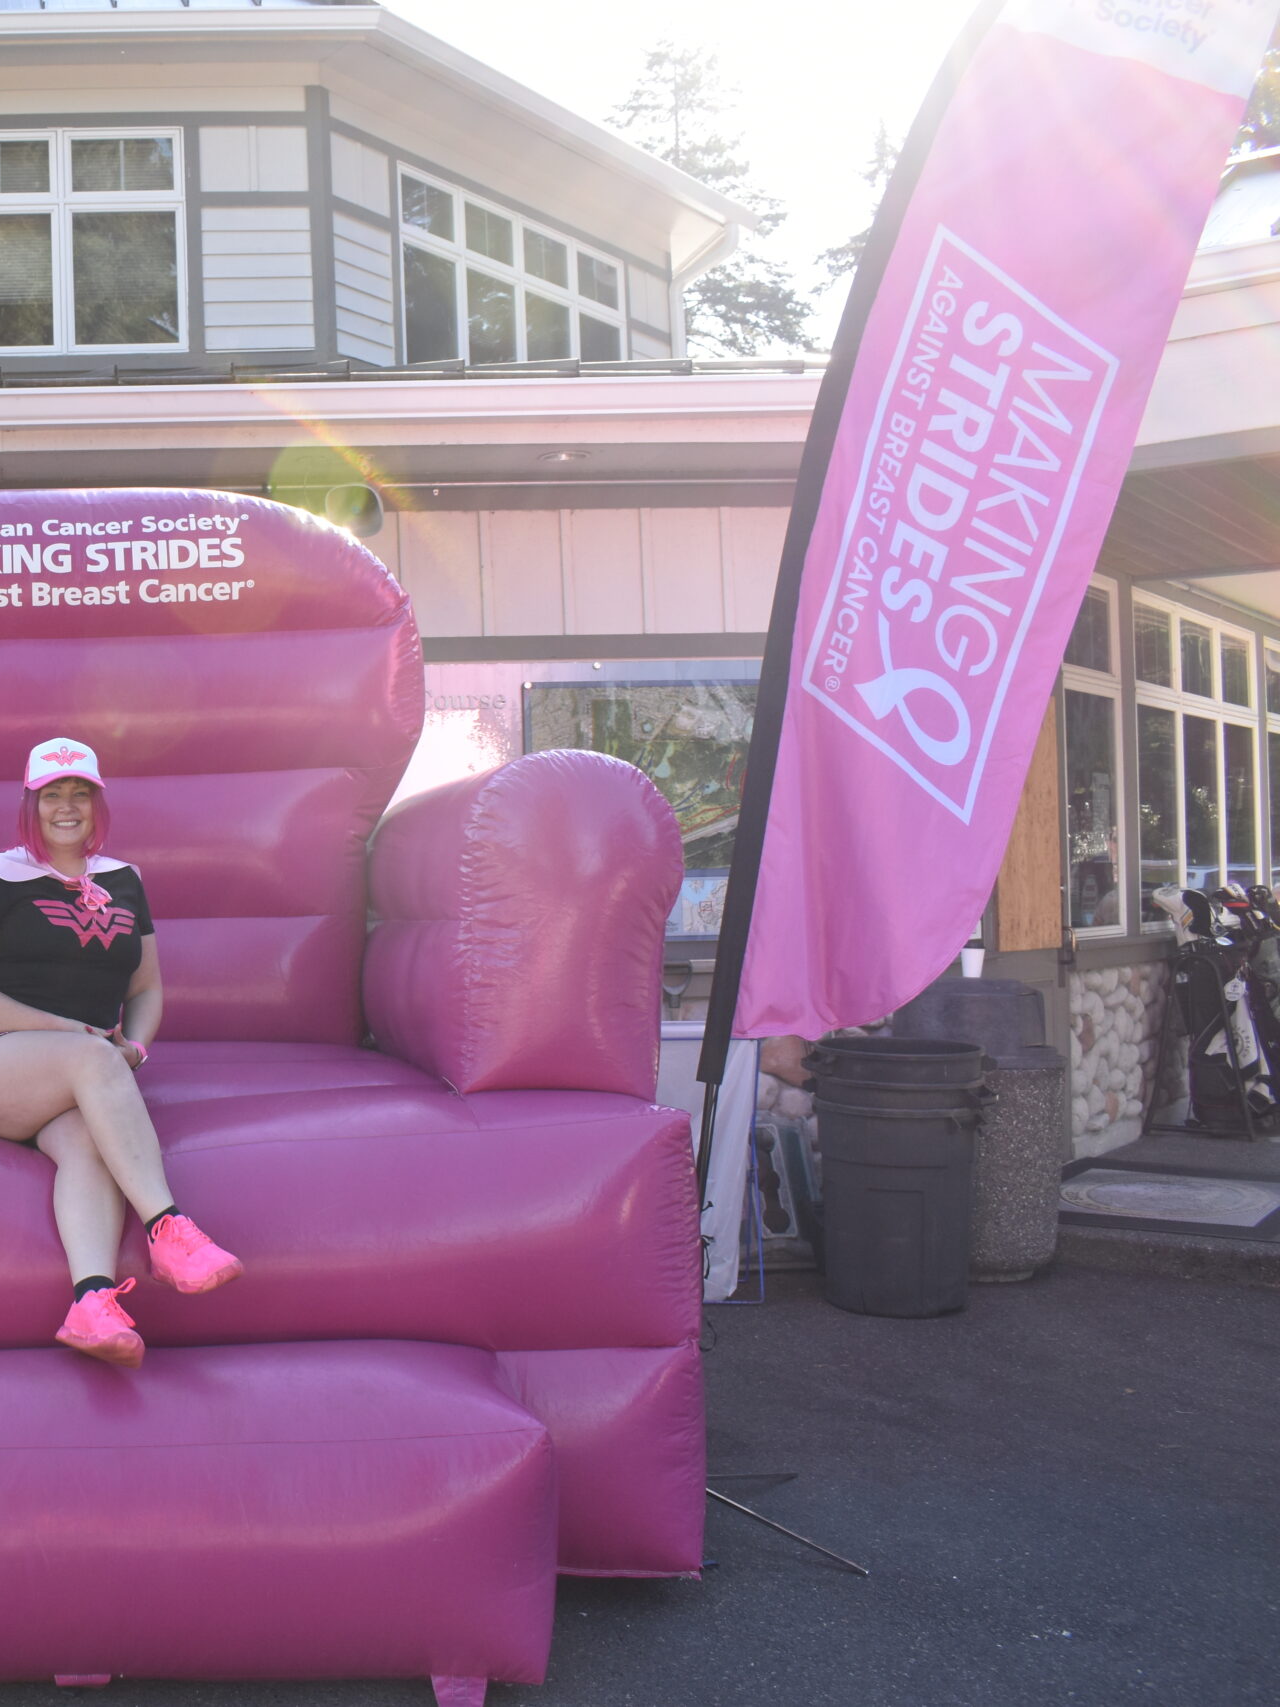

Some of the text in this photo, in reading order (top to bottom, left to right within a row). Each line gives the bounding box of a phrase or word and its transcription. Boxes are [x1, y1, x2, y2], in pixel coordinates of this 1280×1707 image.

[1095, 0, 1208, 55] Society
[901, 265, 964, 410] AGAINST
[866, 411, 917, 535] BREAST
[880, 301, 1023, 623] STRIDES
[41, 519, 133, 536] Cancer
[935, 342, 1093, 676] MAKING
[31, 580, 130, 607] Breast
[85, 537, 245, 573] STRIDES
